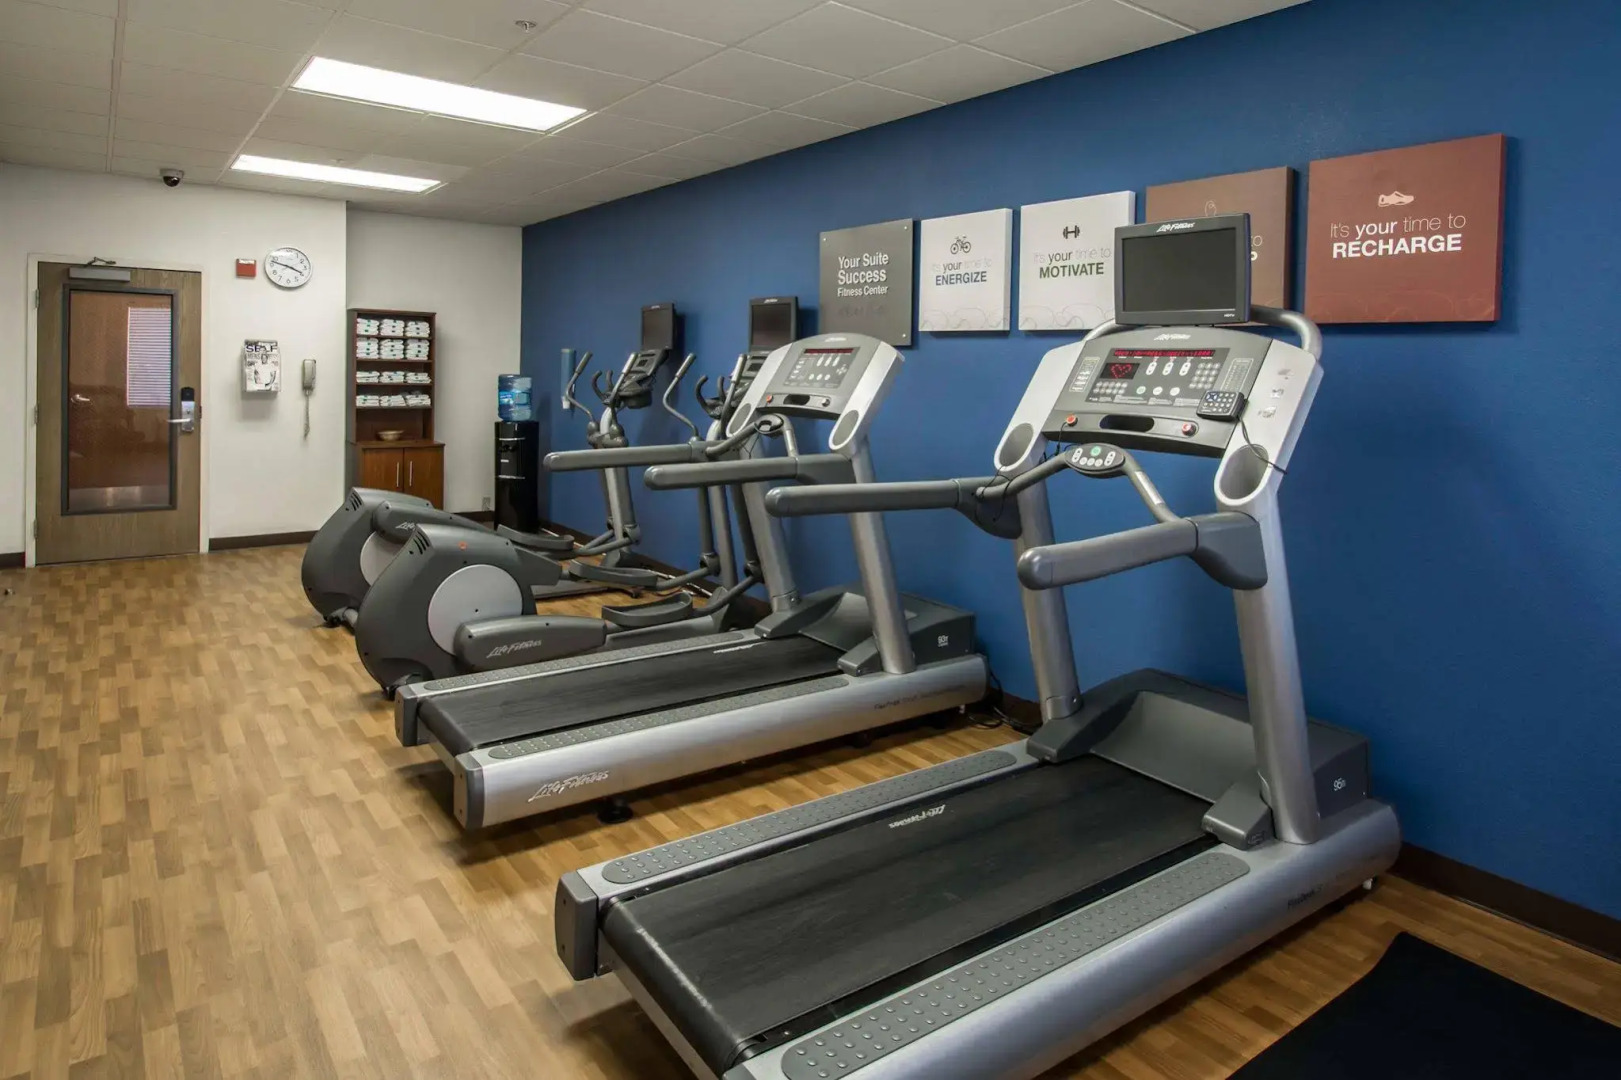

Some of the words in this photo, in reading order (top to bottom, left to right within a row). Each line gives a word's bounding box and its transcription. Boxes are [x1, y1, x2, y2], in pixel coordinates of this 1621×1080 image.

[1330, 222, 1350, 239] It's
[1355, 220, 1398, 241] your
[1403, 215, 1441, 233] time
[1447, 213, 1466, 229] to
[1332, 233, 1463, 259] RECHARGE
[838, 255, 860, 269] Your
[862, 252, 889, 267] Suite
[1048, 250, 1073, 266] your
[943, 260, 963, 274] your
[1039, 262, 1105, 279] MOTIVATE
[837, 269, 887, 285] Success
[935, 271, 988, 286] ENERGIZE
[837, 287, 863, 297] Fitness
[863, 285, 889, 296] Center
